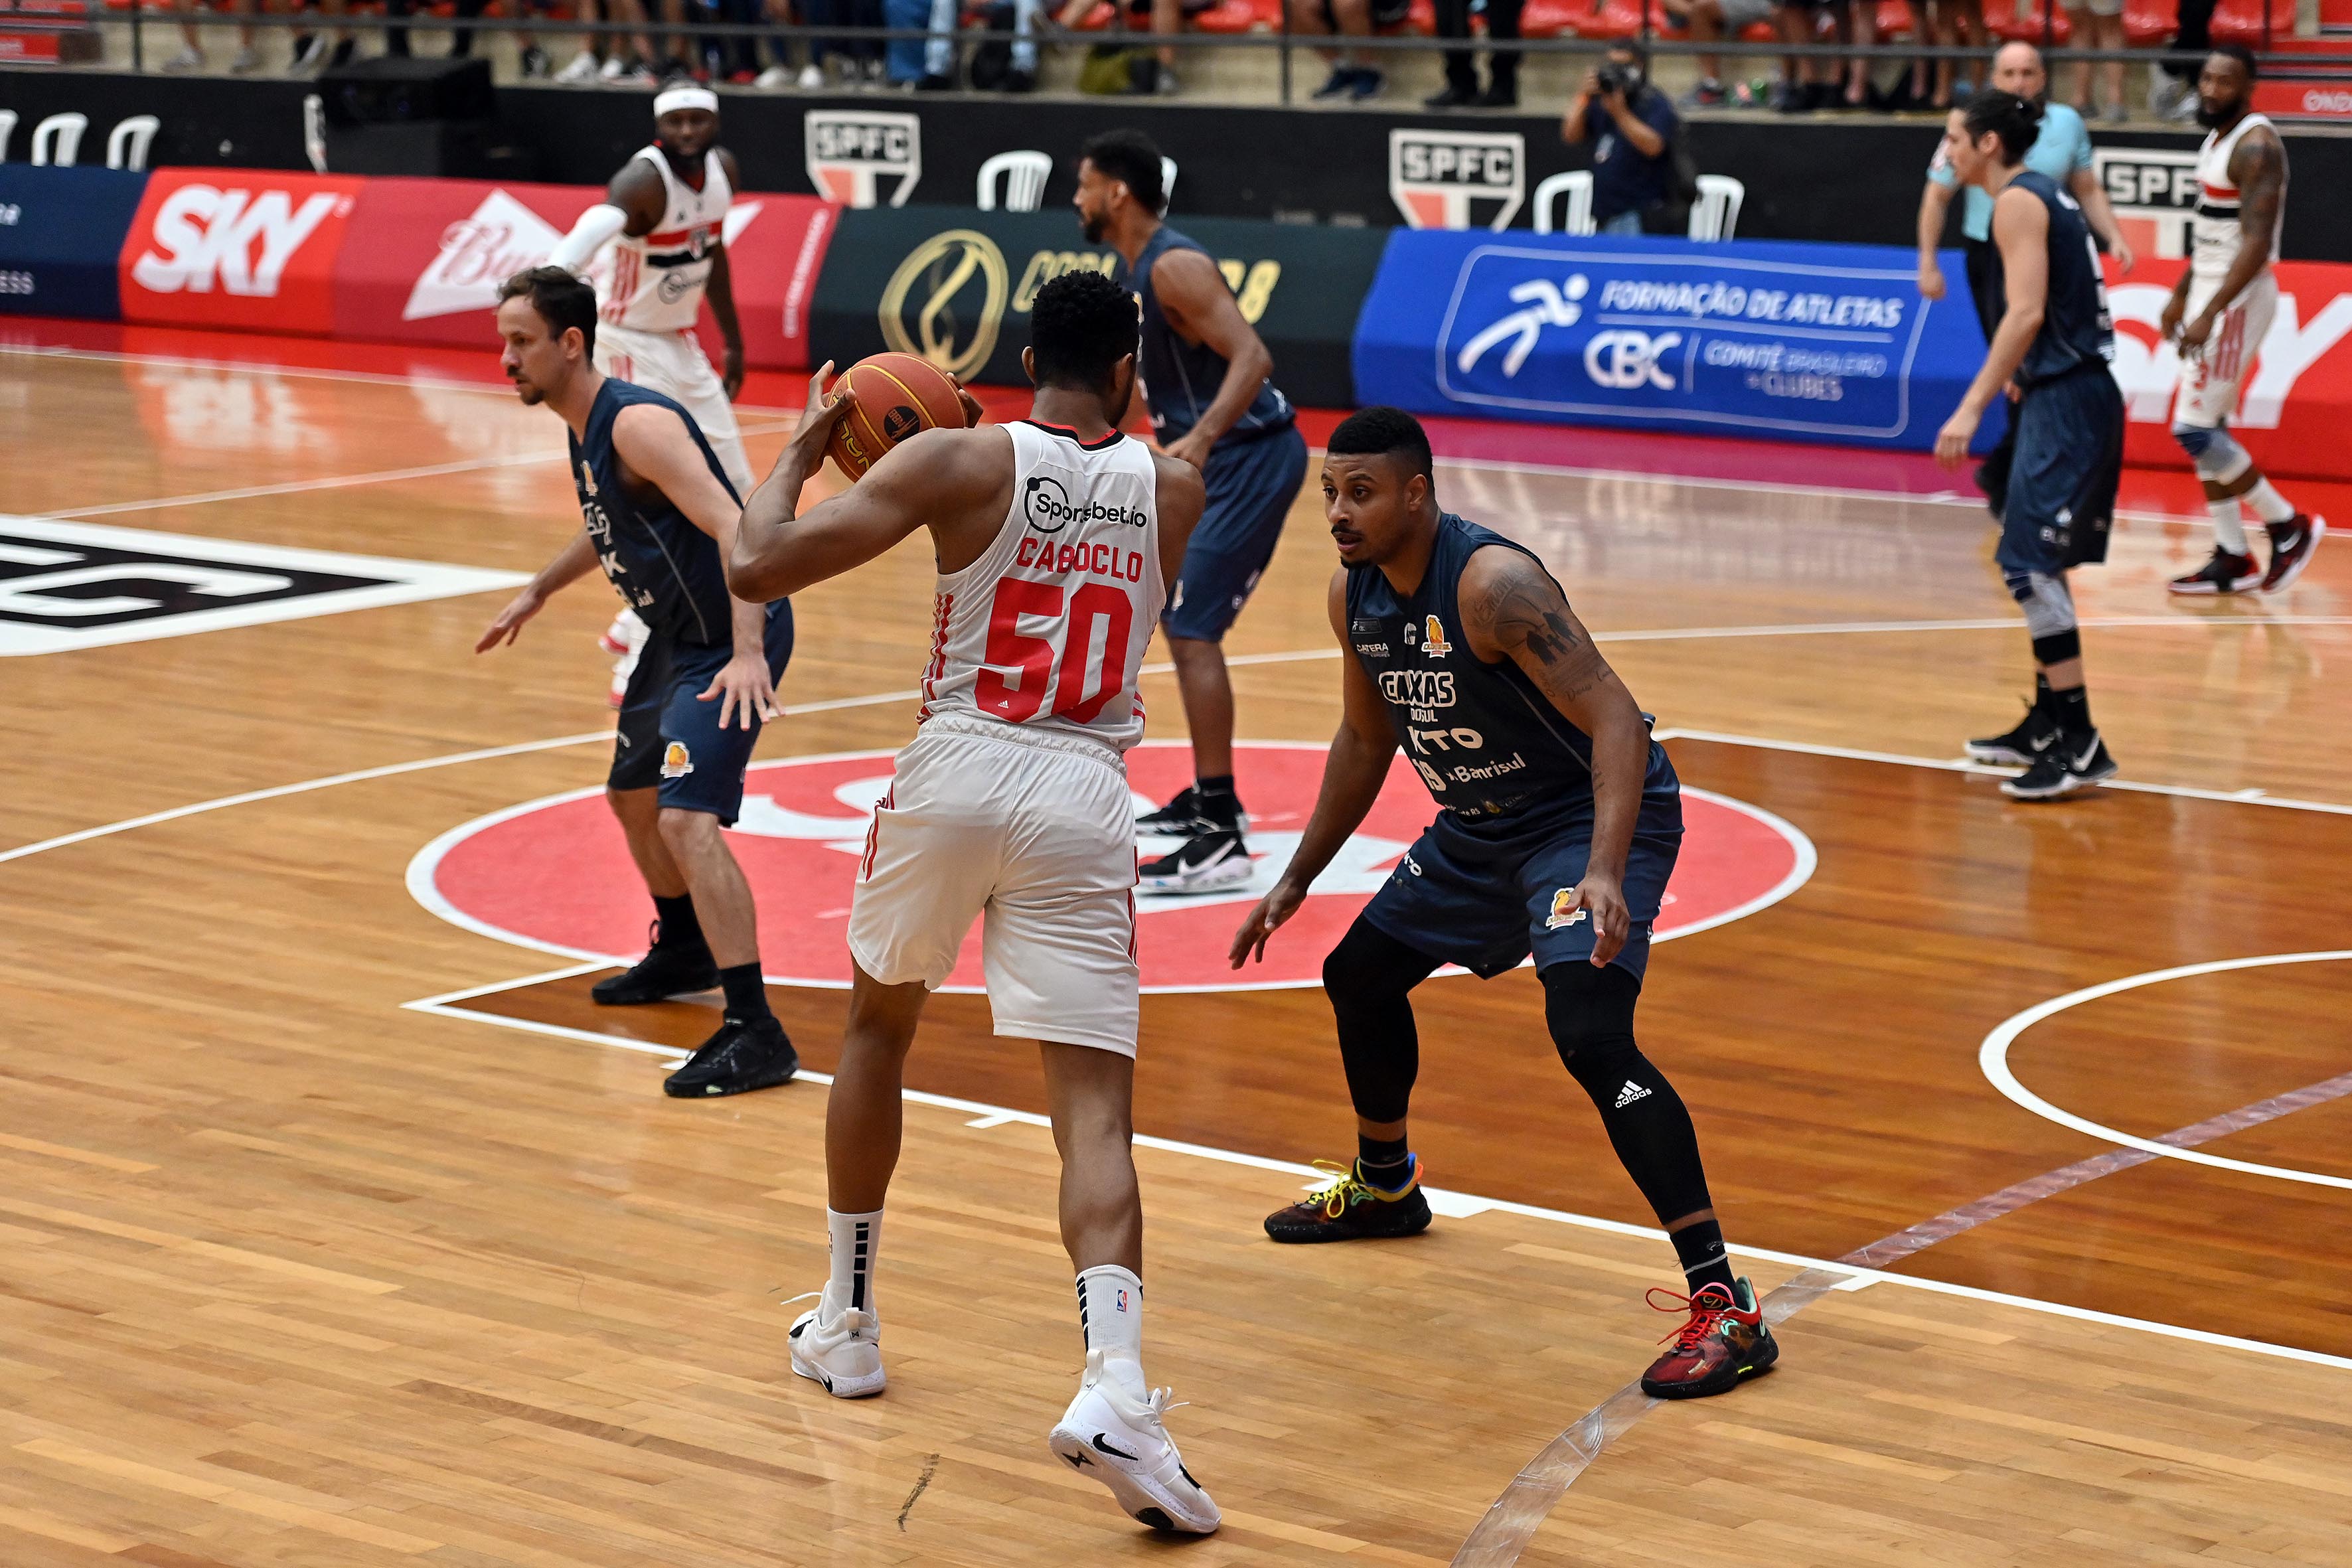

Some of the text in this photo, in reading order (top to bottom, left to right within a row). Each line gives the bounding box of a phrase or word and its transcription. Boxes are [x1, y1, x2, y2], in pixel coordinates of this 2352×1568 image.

[818, 124, 908, 160] SPFC
[1403, 145, 1511, 183] SPFC
[131, 183, 336, 298] SKY
[1599, 279, 1905, 329] FORMAÇÃO DE ATLETAS
[1583, 329, 1683, 392] CBC
[1703, 339, 1786, 371] COMITÊ
[1761, 370, 1844, 402] CLUBES
[1016, 536, 1144, 584] CABOCLO
[973, 576, 1134, 725] 50
[1356, 642, 1389, 653] CATERA
[1406, 726, 1484, 755] KTO
[1454, 751, 1526, 783] Banrisul
[1615, 1088, 1652, 1109] adidas
